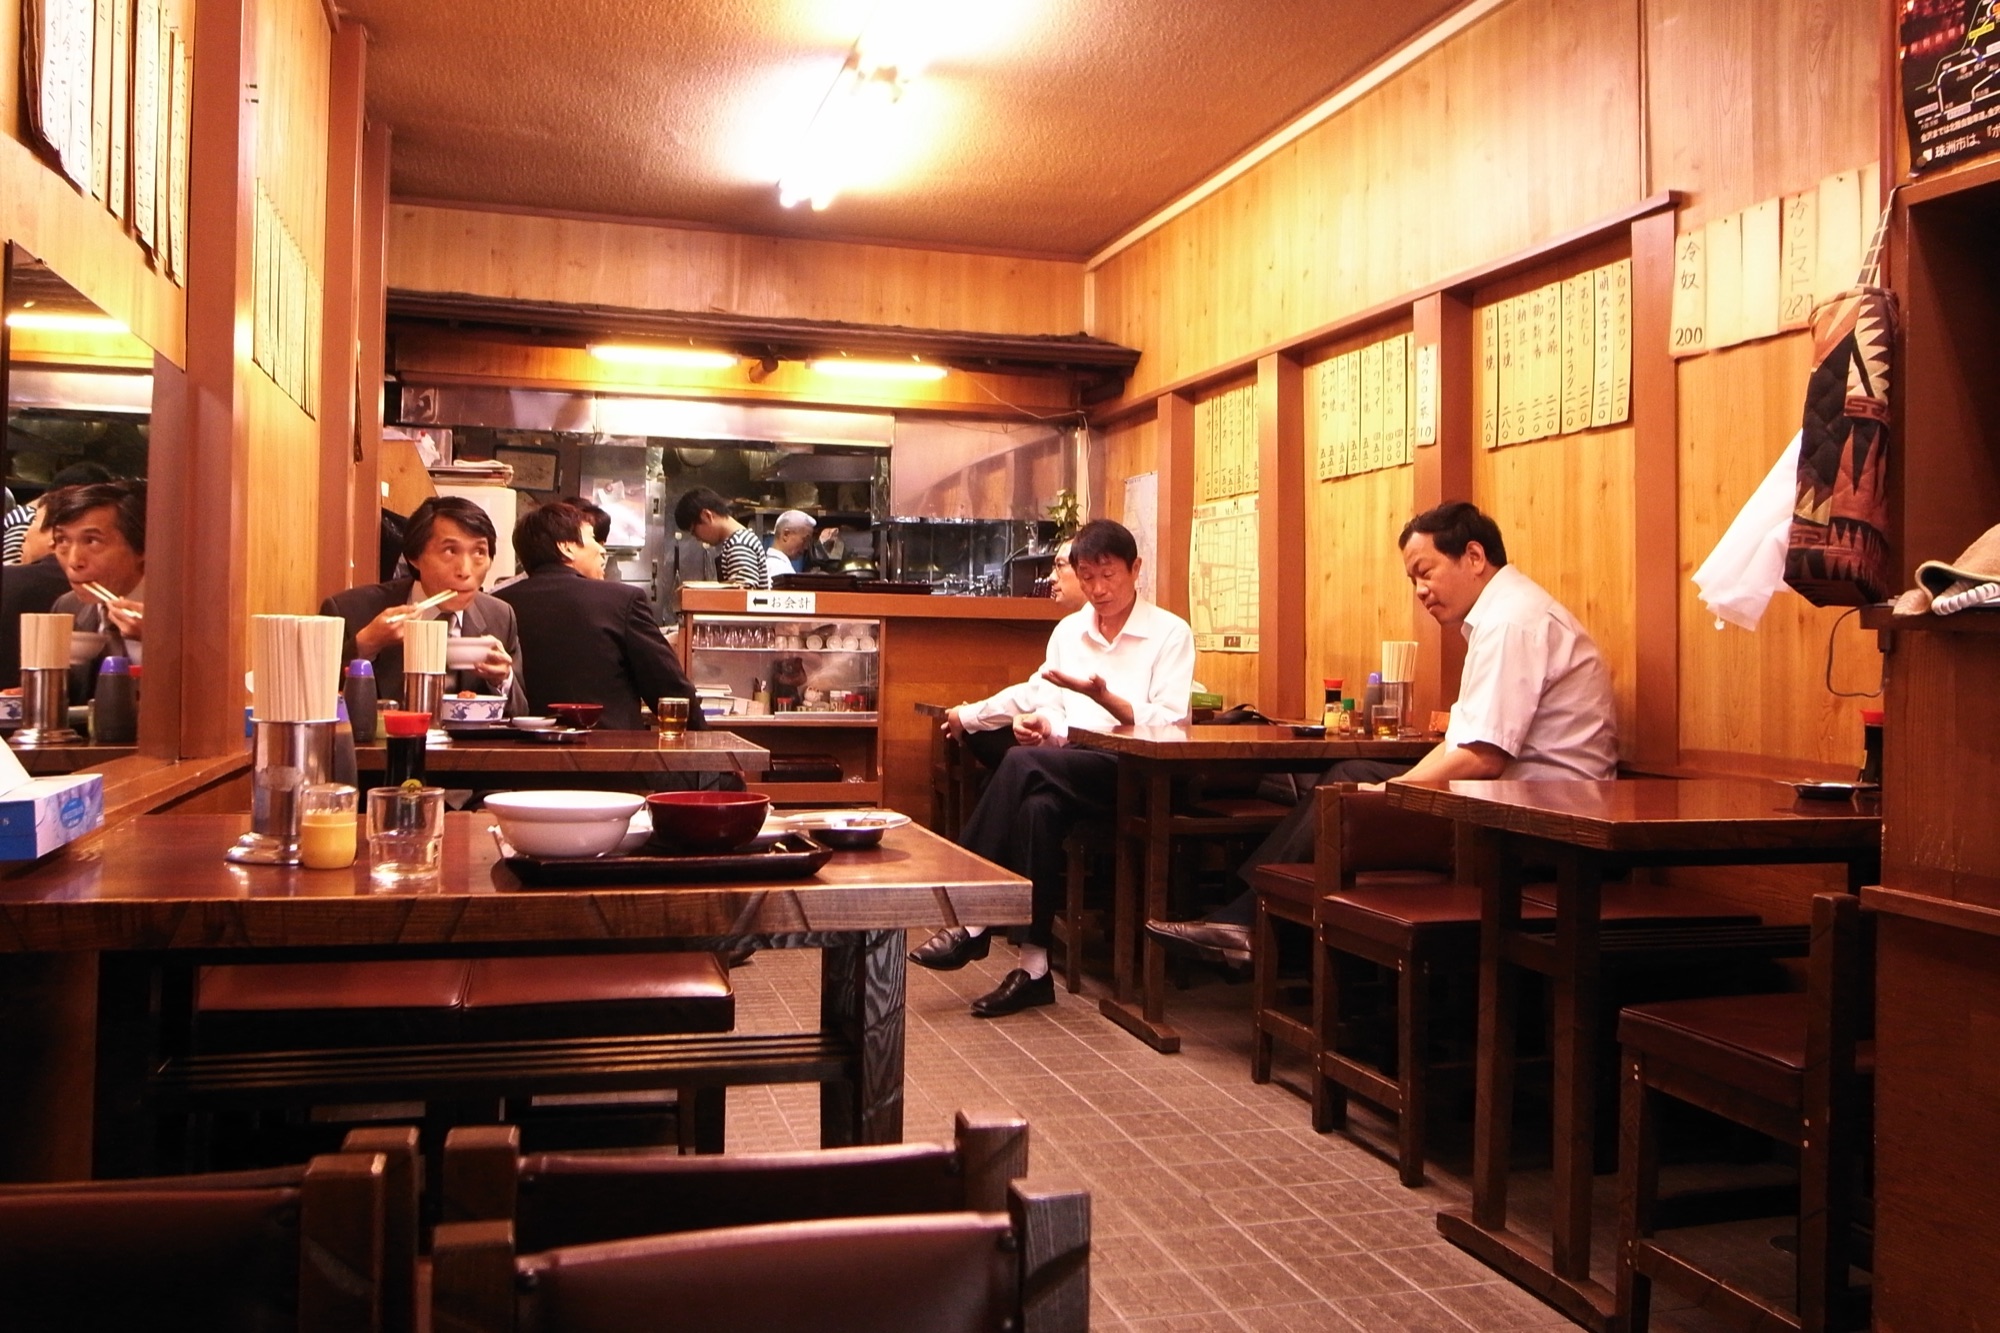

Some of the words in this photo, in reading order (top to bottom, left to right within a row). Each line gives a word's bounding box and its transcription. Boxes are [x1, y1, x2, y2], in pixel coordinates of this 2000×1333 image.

[1790, 200, 1809, 293] 冷しトマト
[1680, 240, 1701, 291] 冷奴
[1675, 326, 1704, 347] 200
[771, 596, 811, 610] お会計
